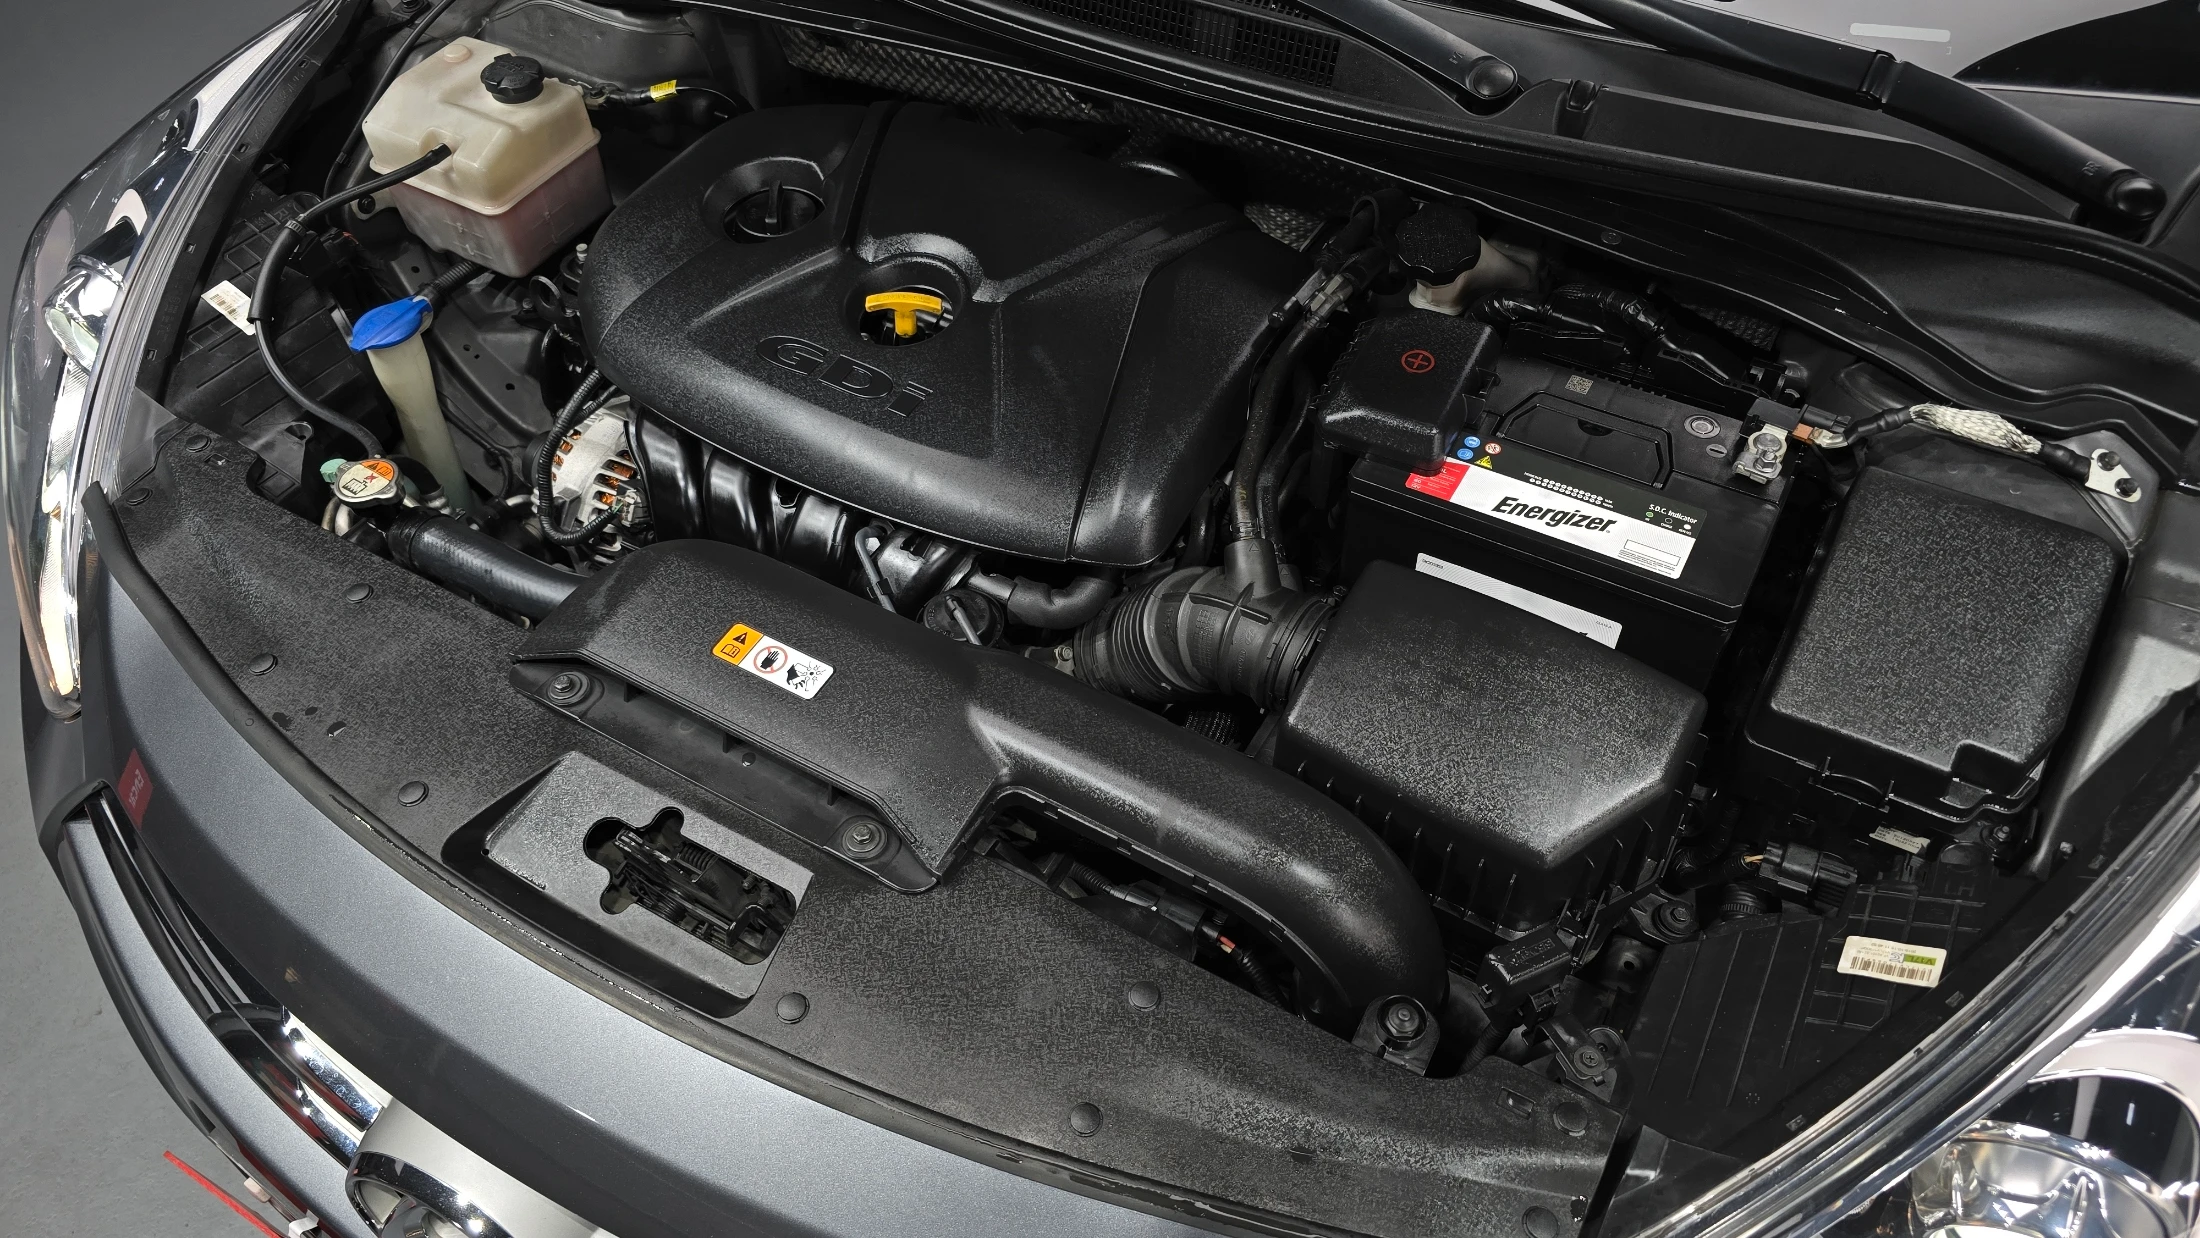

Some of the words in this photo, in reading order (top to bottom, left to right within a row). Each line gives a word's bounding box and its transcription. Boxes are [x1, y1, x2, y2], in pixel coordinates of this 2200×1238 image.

[756, 335, 934, 417] GDi
[1491, 496, 1618, 533] Energizer
[1648, 503, 1667, 515] S.D.C.
[1667, 510, 1698, 524] Indicator
